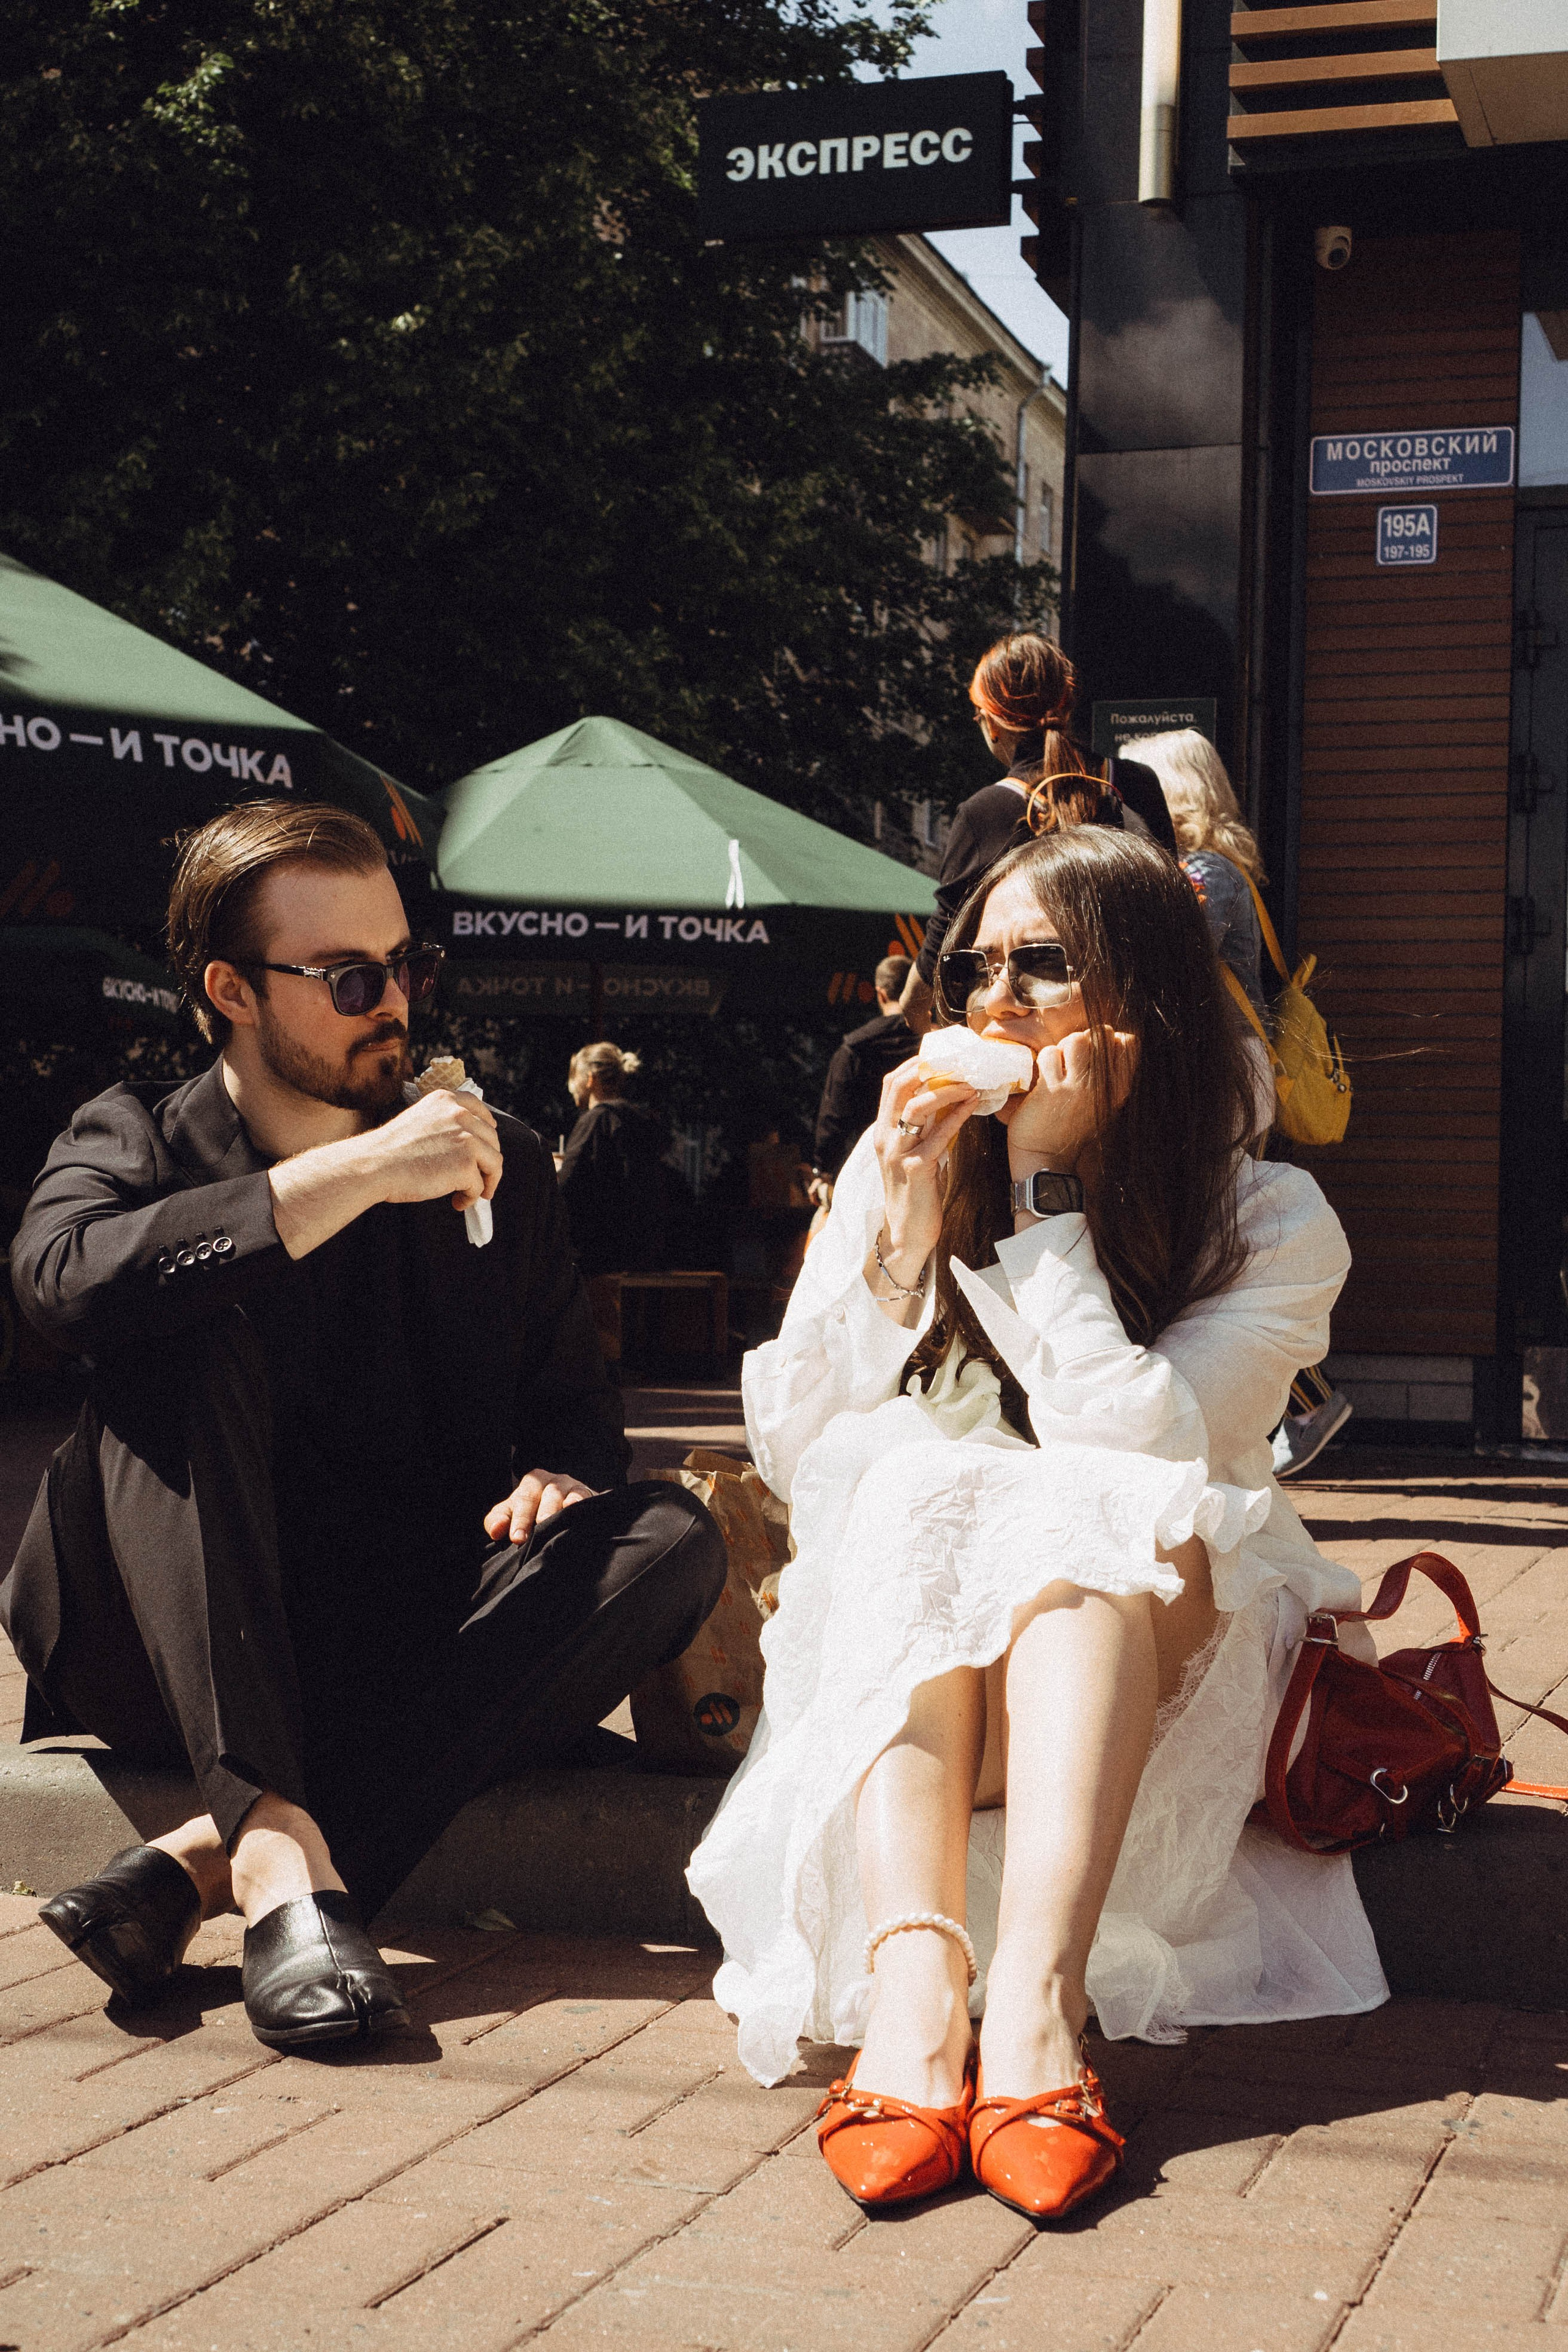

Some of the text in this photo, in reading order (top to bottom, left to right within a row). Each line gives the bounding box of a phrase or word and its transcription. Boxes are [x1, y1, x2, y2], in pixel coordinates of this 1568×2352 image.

[726, 127, 973, 181] ЭКСПРЕСС
[1327, 430, 1498, 461] МОСКОВСКИЙ
[1357, 474, 1463, 487] MOSKOVSKIY PROSPEKT
[1370, 458, 1451, 476] проспект
[1383, 545, 1430, 559] 197-195
[110, 728, 143, 762] И
[153, 733, 293, 788] ТОЧКА
[453, 911, 589, 937] ВКУСНО
[626, 915, 647, 938] И
[659, 916, 770, 944] ТОЧКА
